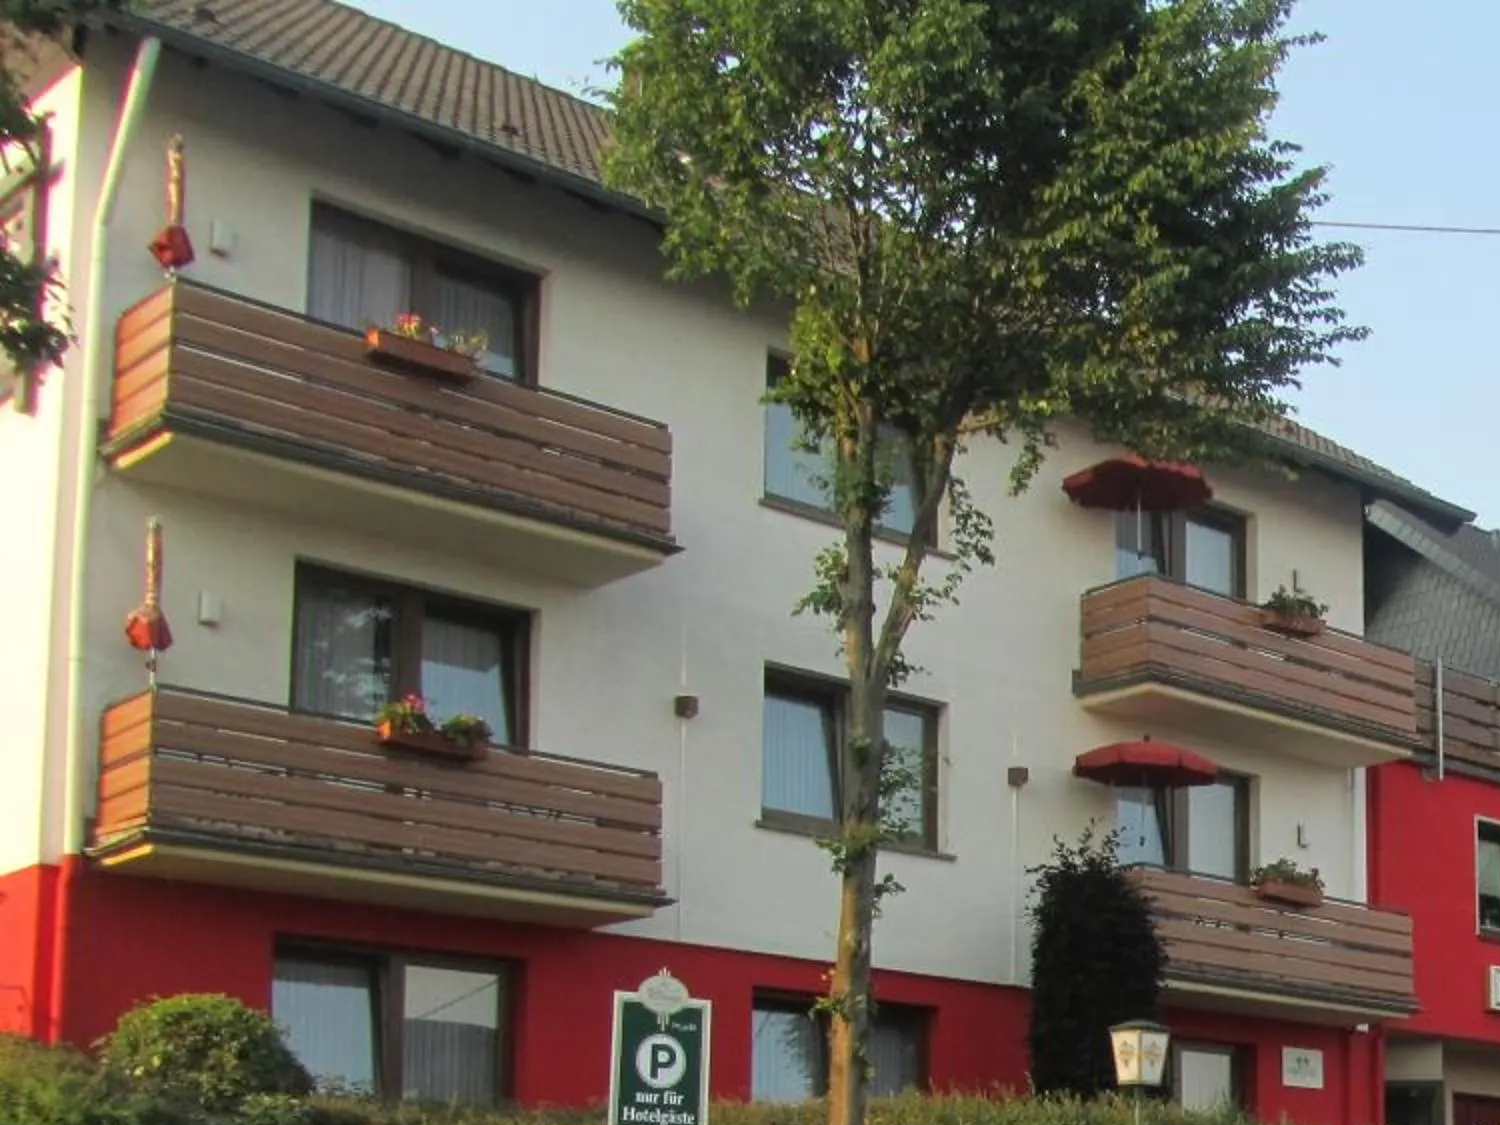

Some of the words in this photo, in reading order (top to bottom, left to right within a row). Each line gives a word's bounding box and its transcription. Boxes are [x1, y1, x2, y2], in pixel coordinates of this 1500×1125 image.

[650, 1043, 677, 1080] P
[635, 1091, 660, 1104] nur
[663, 1090, 685, 1106] für
[623, 1106, 695, 1125] Hotelgäste
